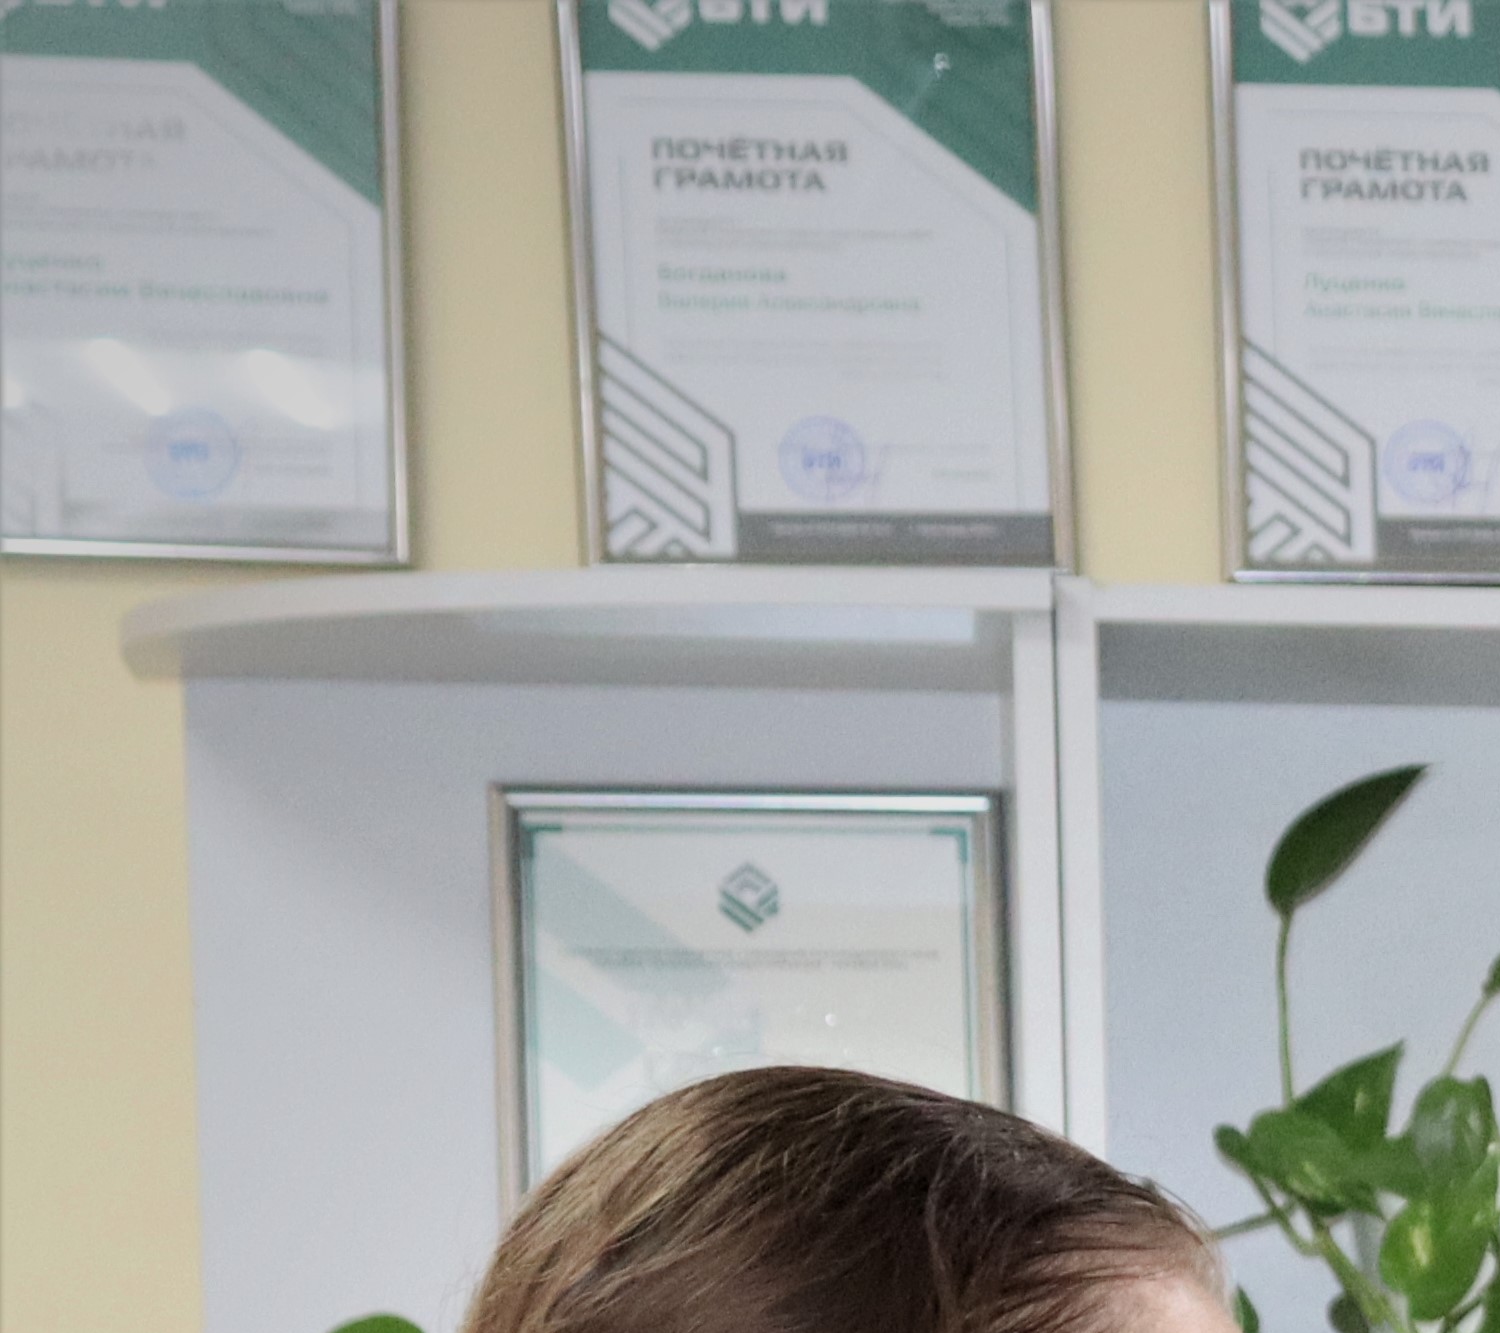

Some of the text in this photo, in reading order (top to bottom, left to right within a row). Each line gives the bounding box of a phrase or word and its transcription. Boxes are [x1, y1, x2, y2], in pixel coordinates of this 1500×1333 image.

[1347, 0, 1474, 37] БТИ
[652, 136, 848, 166] ПОЧЁТНАЯ
[1299, 146, 1490, 173] ПОЧЁТНАЯ
[654, 168, 827, 193] ГРАМОТА
[1301, 178, 1467, 203] ГРАМОТА
